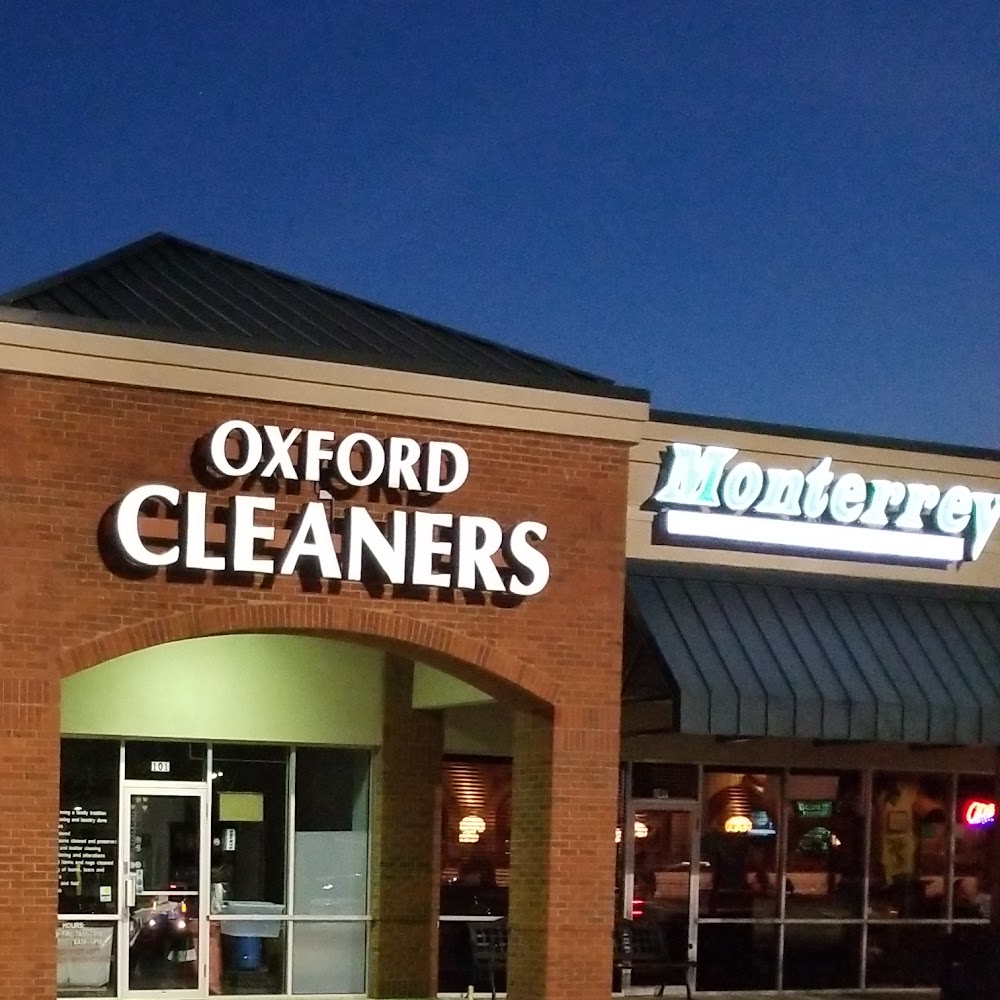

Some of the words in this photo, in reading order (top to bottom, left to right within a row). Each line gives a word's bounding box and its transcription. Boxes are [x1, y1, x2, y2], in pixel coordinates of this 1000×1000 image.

[210, 419, 470, 494] OXFORD
[654, 442, 1000, 562] Monterrey
[116, 484, 551, 596] CLEANERS
[153, 762, 168, 771] 101
